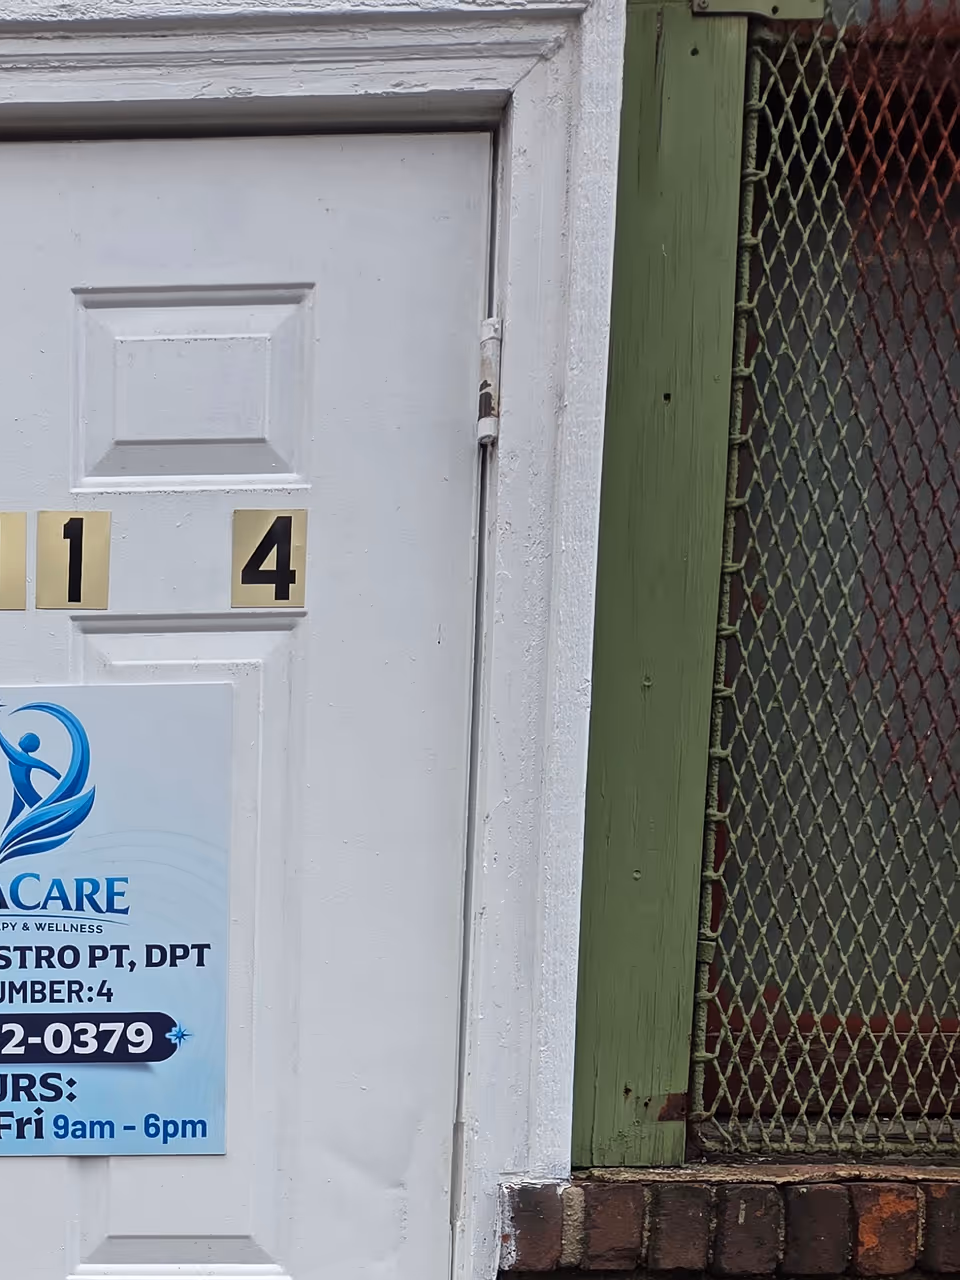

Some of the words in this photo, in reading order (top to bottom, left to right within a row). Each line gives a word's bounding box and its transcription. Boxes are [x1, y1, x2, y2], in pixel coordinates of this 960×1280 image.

[241, 516, 296, 600] 4
[22, 922, 30, 932] &
[34, 923, 103, 933] WELLNESS
[88, 945, 136, 972] PT,
[145, 943, 211, 968] DPT
[52, 1114, 115, 1139] 9am
[143, 1113, 207, 1144] 6pm
